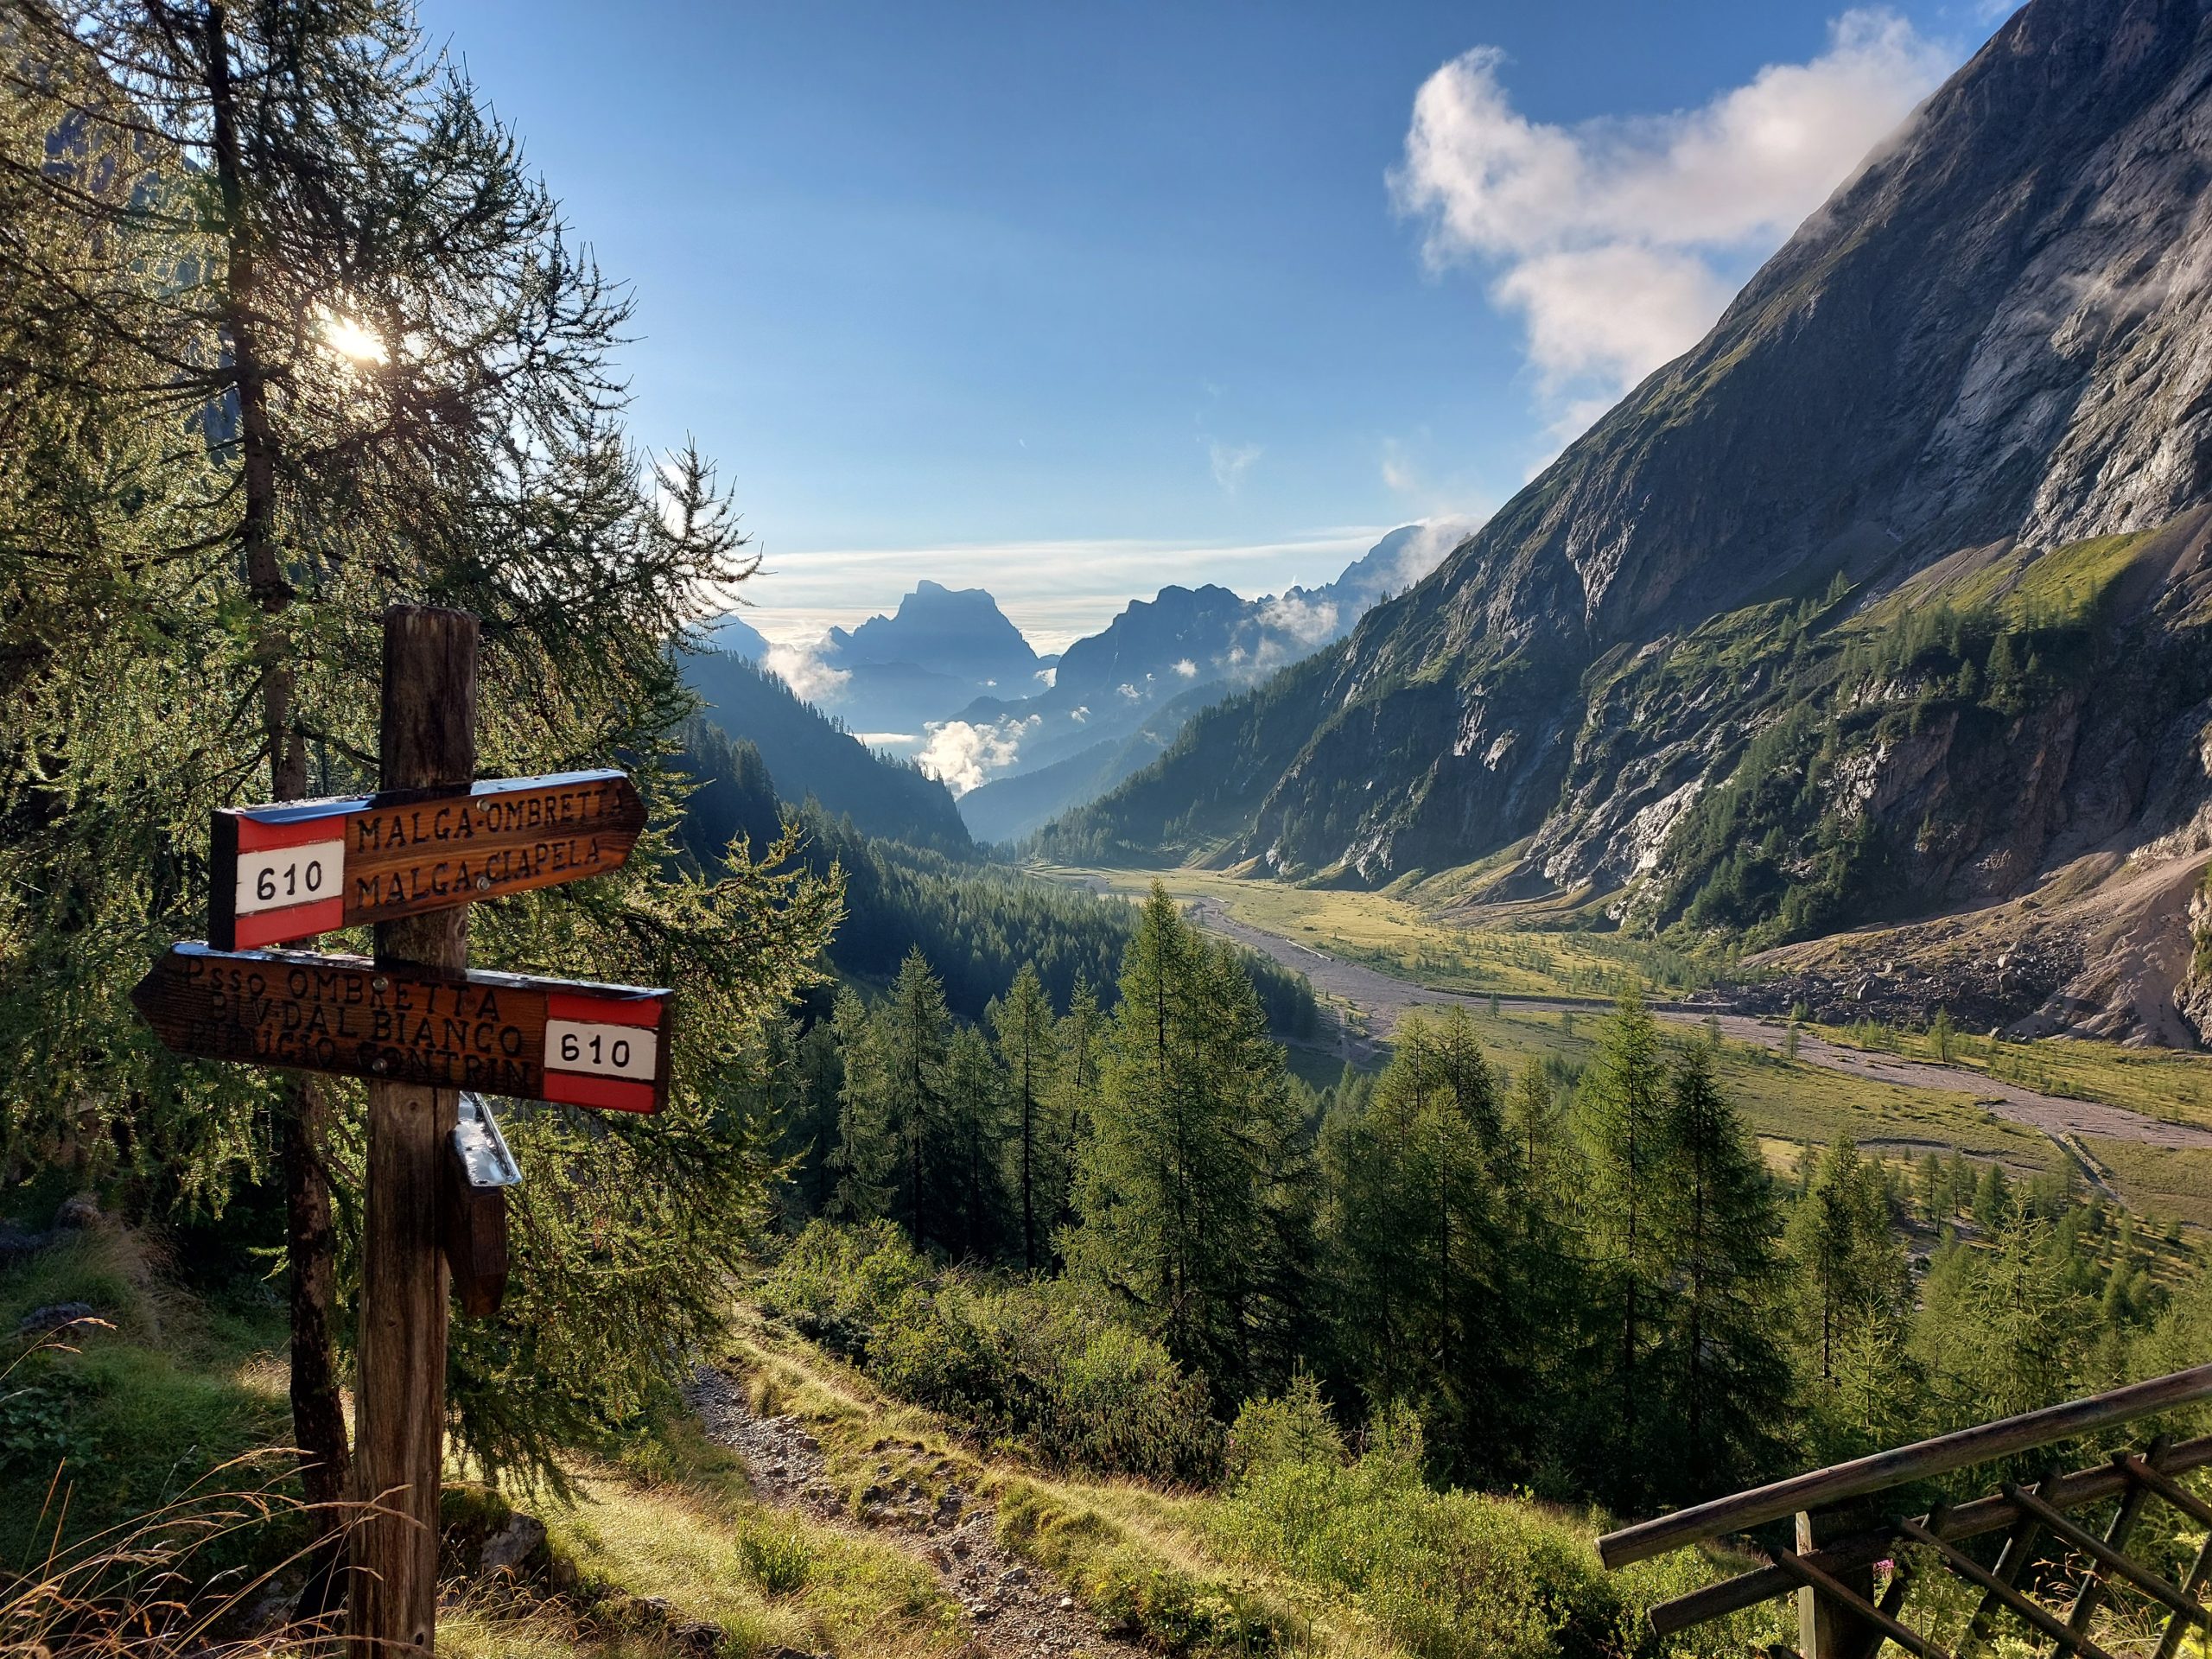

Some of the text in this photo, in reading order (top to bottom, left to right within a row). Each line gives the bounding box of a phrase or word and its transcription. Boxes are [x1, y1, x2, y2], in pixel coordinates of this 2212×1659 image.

[257, 861, 321, 900] 610
[288, 968, 500, 1022] OMBRETTA
[372, 1009, 522, 1057] BIANCO
[562, 1033, 630, 1068] 610
[356, 1040, 531, 1089] CONTRIN
